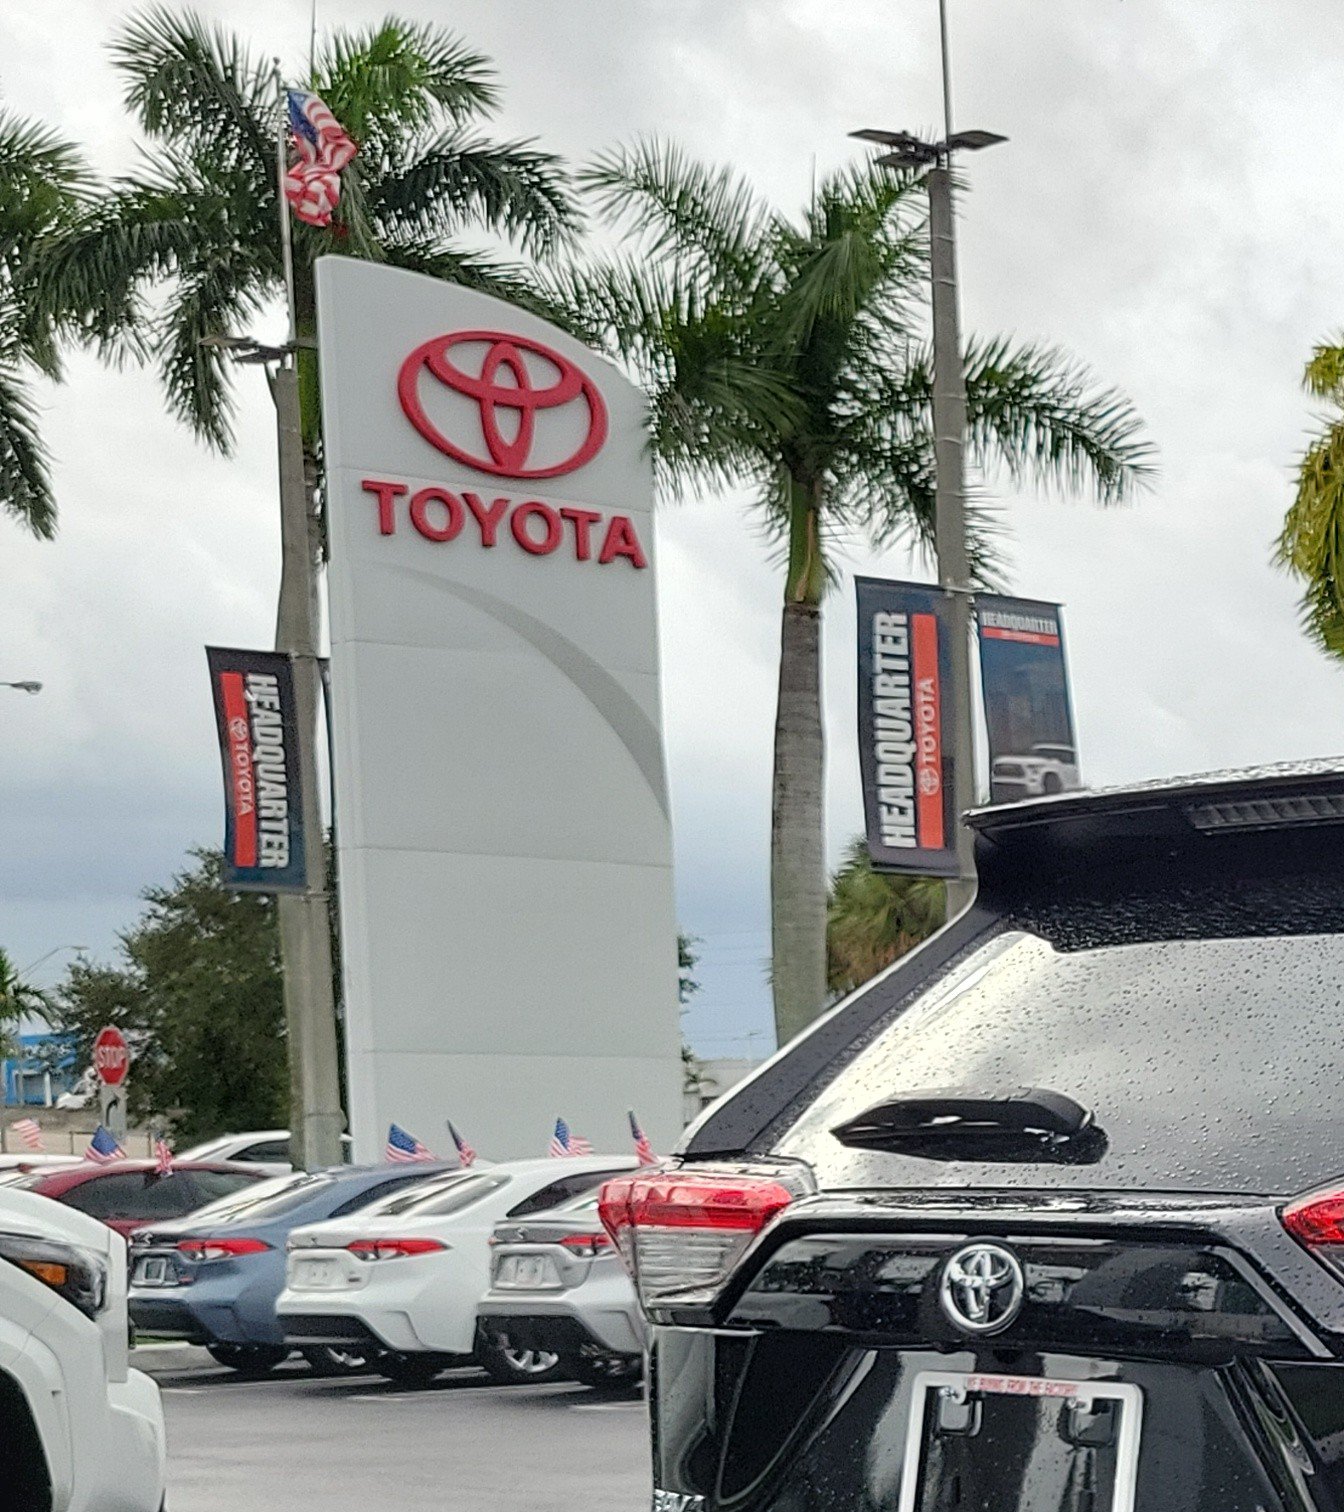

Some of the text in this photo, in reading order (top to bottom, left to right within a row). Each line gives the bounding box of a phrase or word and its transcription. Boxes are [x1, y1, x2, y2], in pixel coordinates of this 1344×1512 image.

[362, 480, 647, 569] TOYOTA
[873, 612, 916, 848] HEADQUARTER
[918, 678, 938, 765] TOYOTA
[234, 742, 256, 816] TOYOTA
[244, 672, 289, 867] HEADQUARTER
[98, 1045, 128, 1069] STOP
